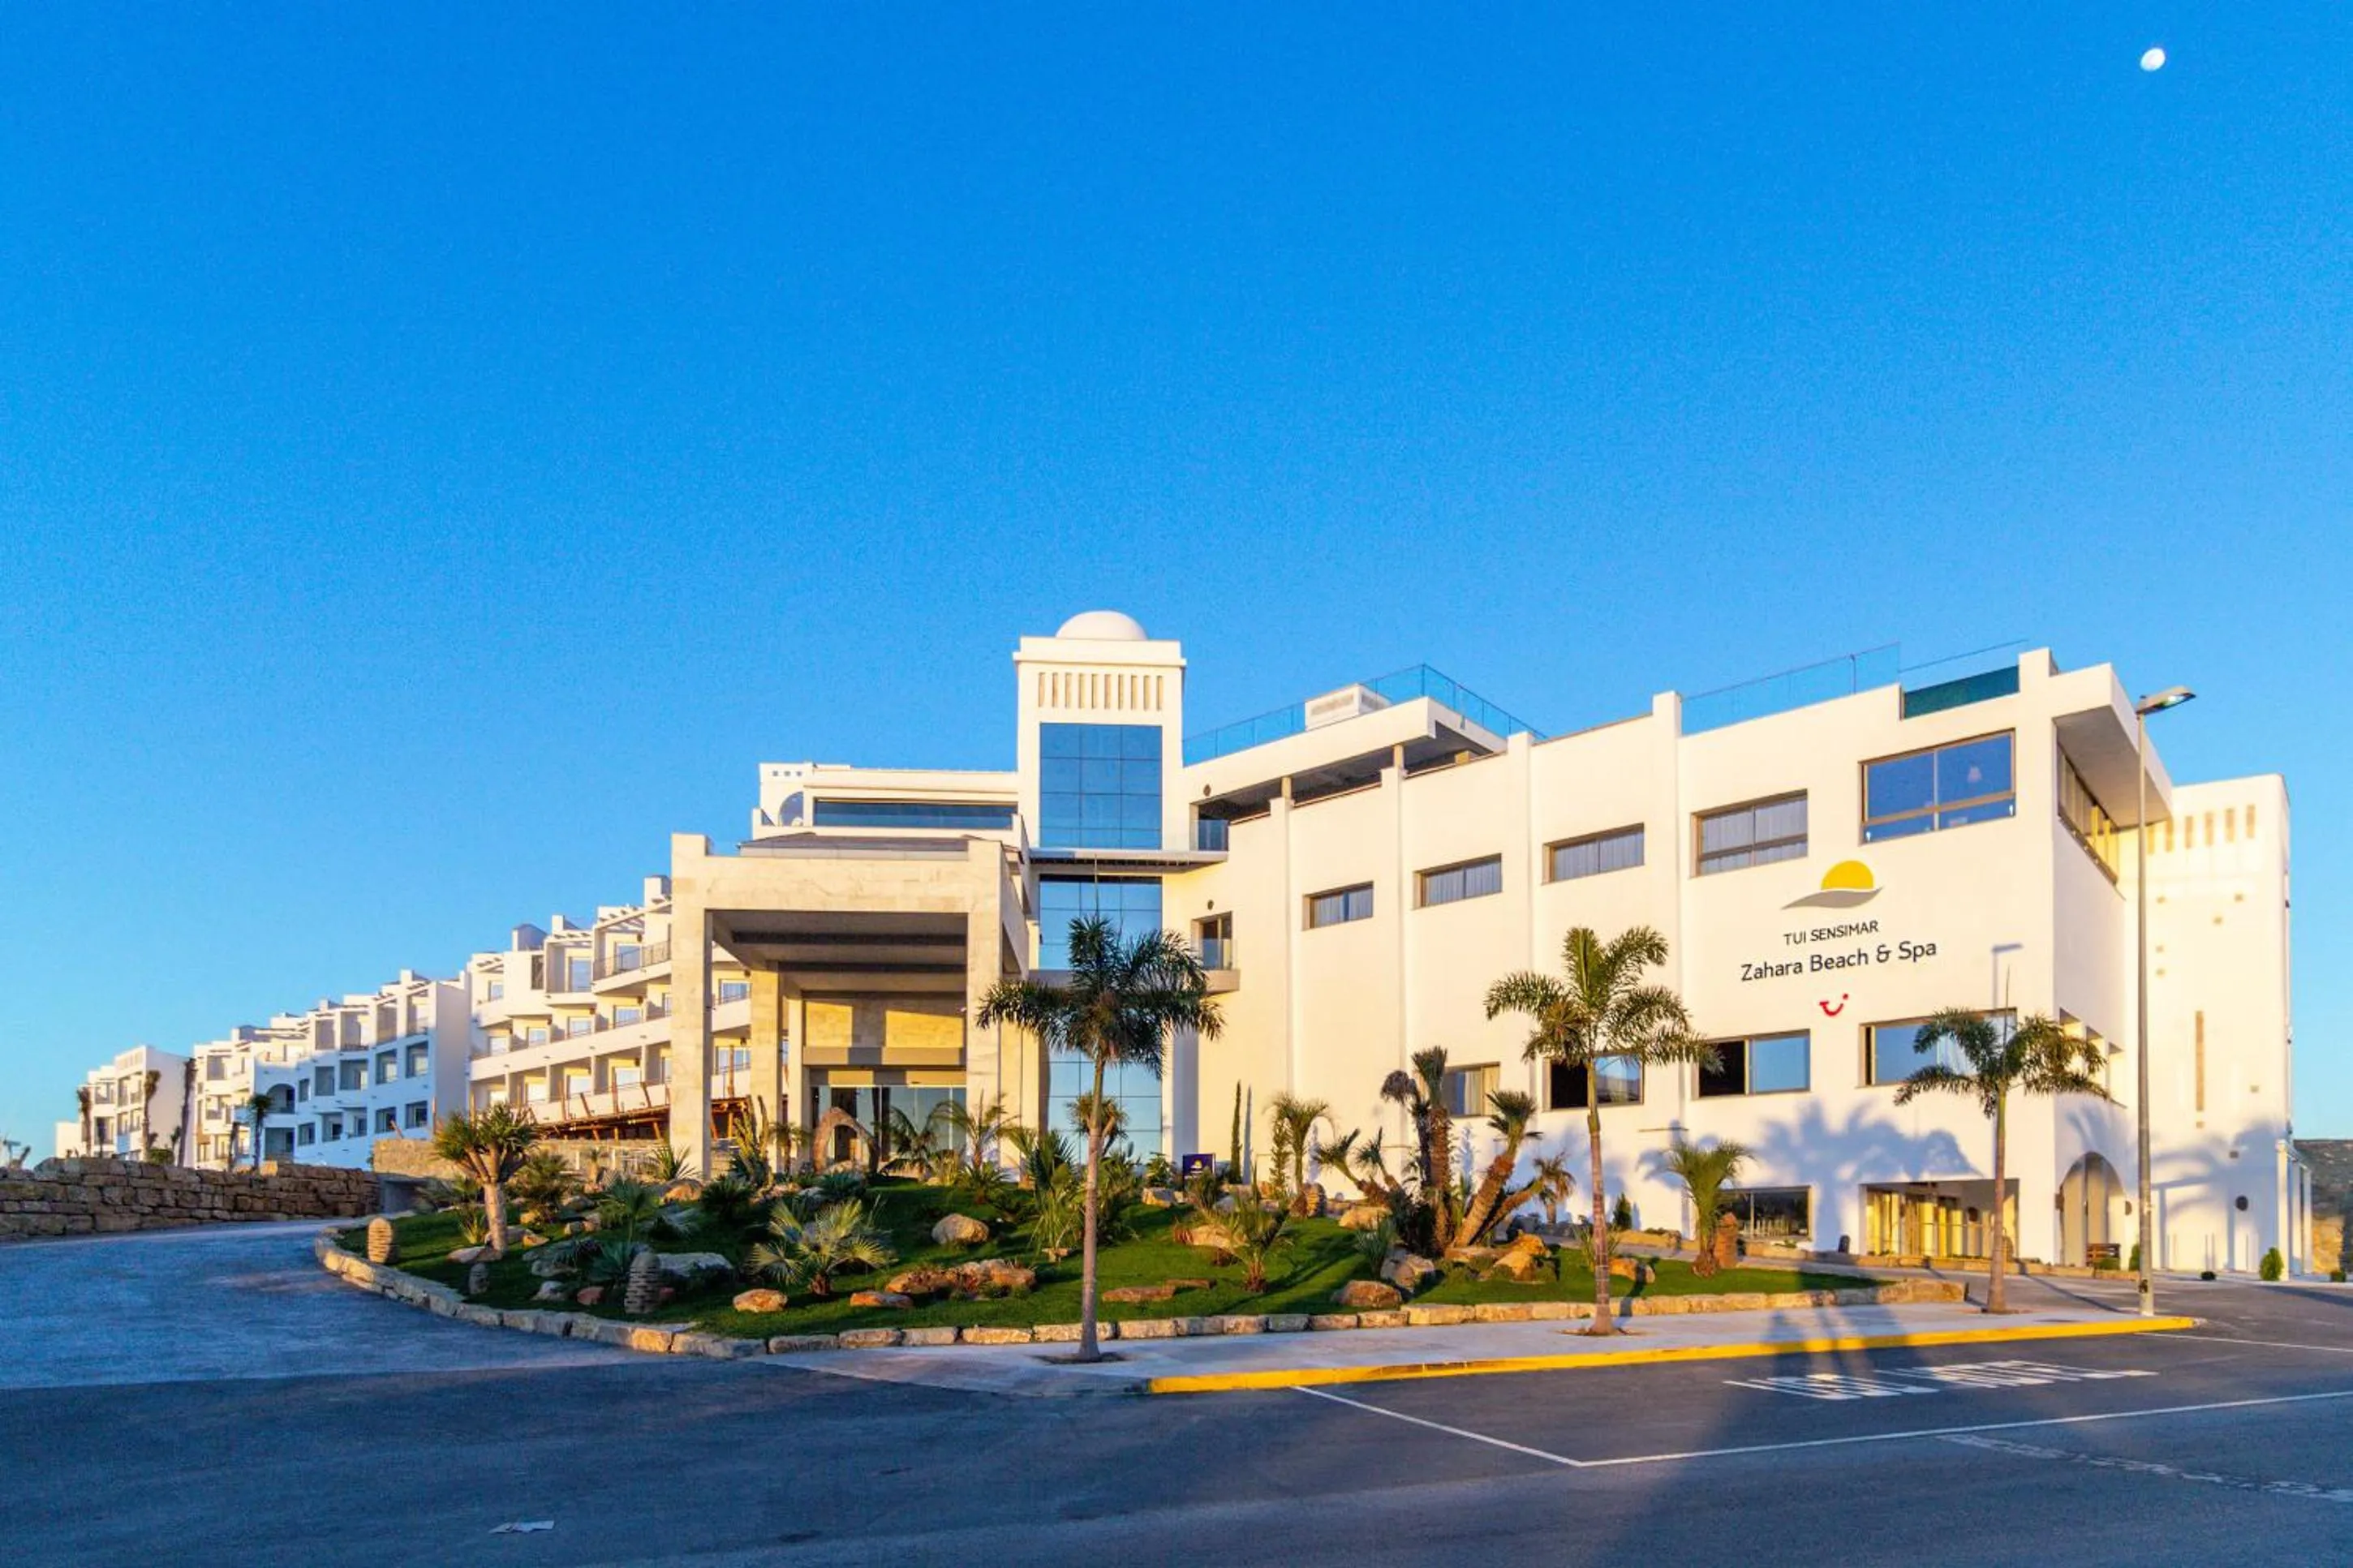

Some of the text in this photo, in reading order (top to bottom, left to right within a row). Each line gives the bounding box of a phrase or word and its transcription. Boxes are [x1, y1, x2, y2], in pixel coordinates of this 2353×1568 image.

[1783, 920, 1879, 946] TUI SENSIMAR
[1740, 940, 1938, 982] Zahara Beach & Spa
